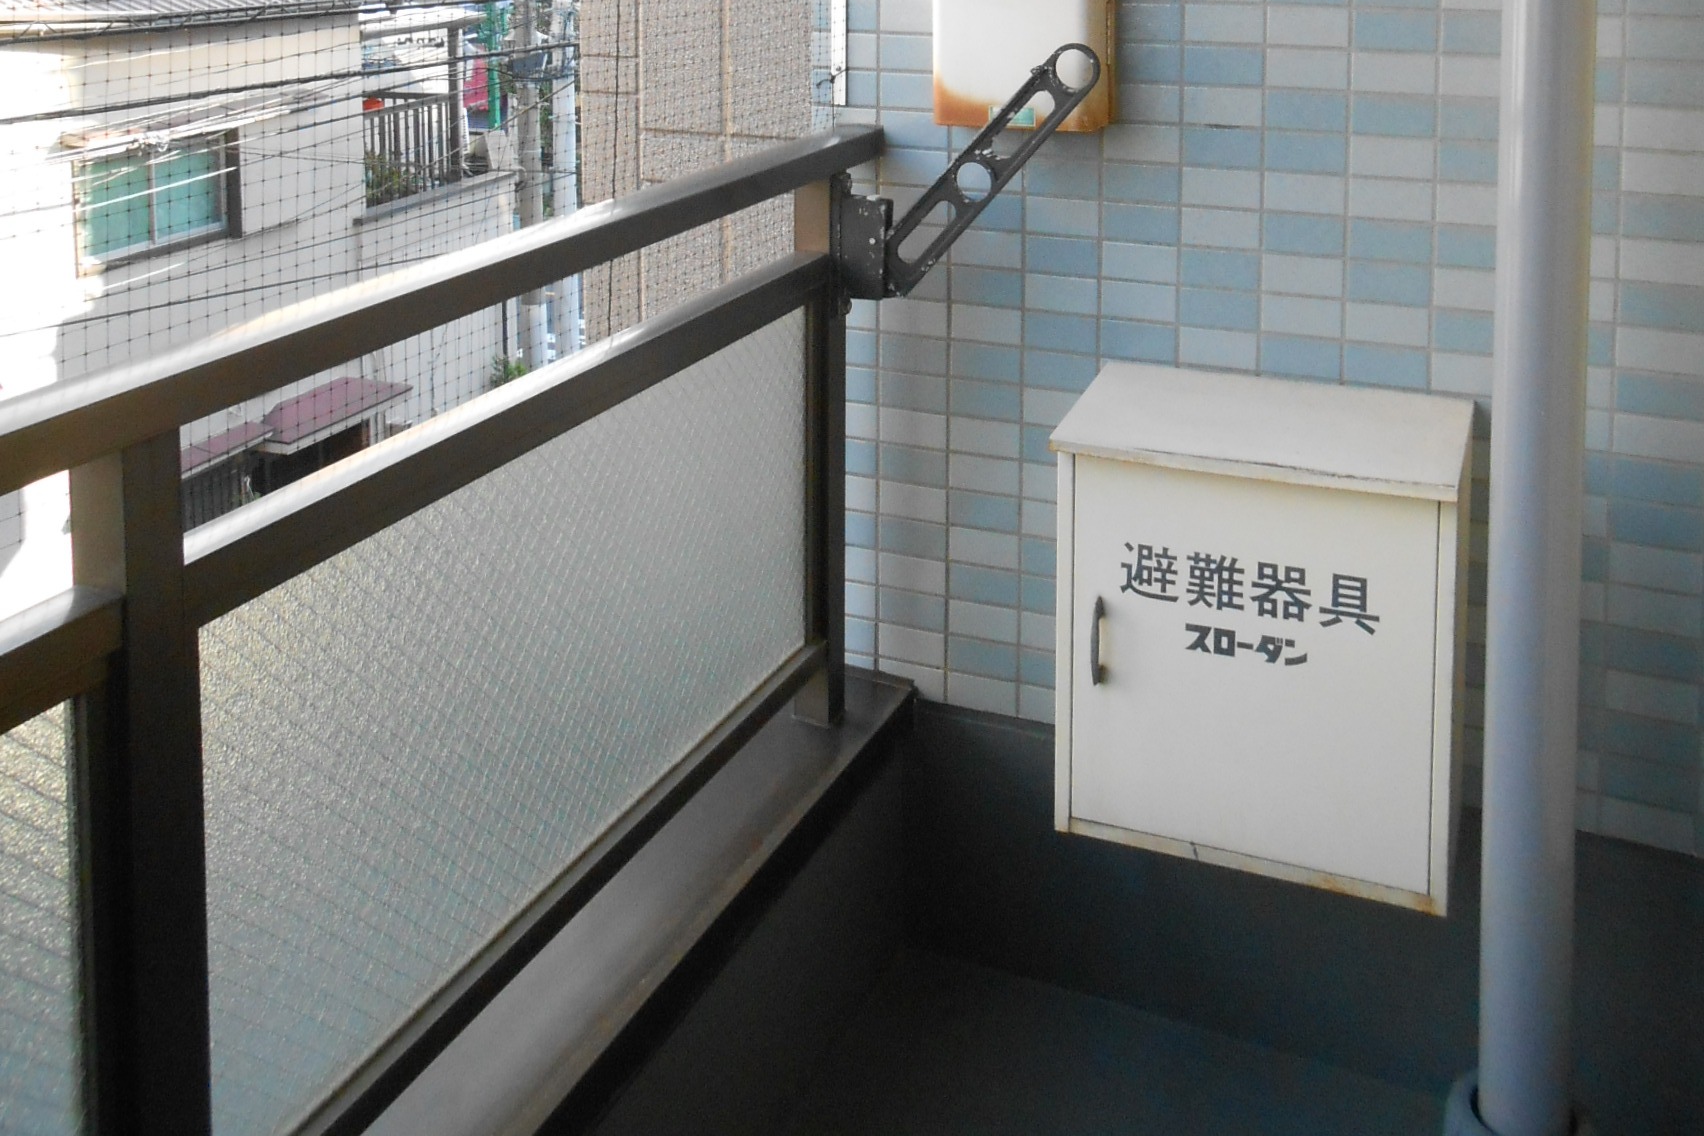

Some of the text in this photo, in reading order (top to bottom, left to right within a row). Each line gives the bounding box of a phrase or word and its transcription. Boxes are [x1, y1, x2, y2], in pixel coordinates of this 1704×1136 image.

[1120, 542, 1380, 635] 避難器具
[1185, 623, 1308, 666] スローダン
